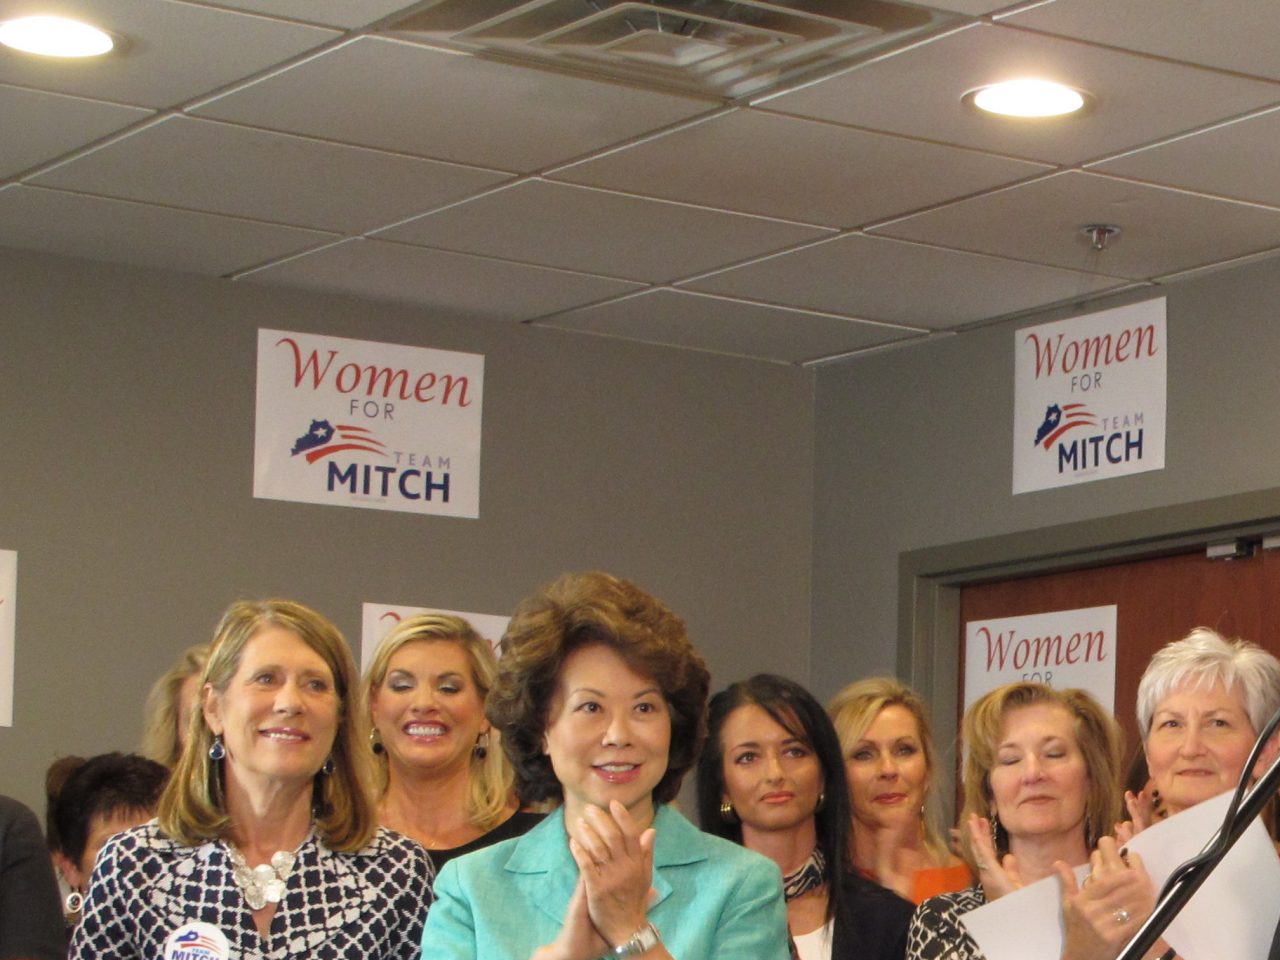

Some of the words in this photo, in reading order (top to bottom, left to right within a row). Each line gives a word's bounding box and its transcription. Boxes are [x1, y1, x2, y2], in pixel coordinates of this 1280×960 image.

[275, 338, 472, 408] Women
[1025, 324, 1159, 380] Women
[1071, 371, 1103, 393] FOR
[350, 399, 395, 420] FOR
[1102, 411, 1145, 431] TEAM
[394, 451, 451, 469] TEAM
[1058, 428, 1144, 474] MITCH
[327, 461, 450, 503] MITCH
[975, 626, 1108, 673] Women
